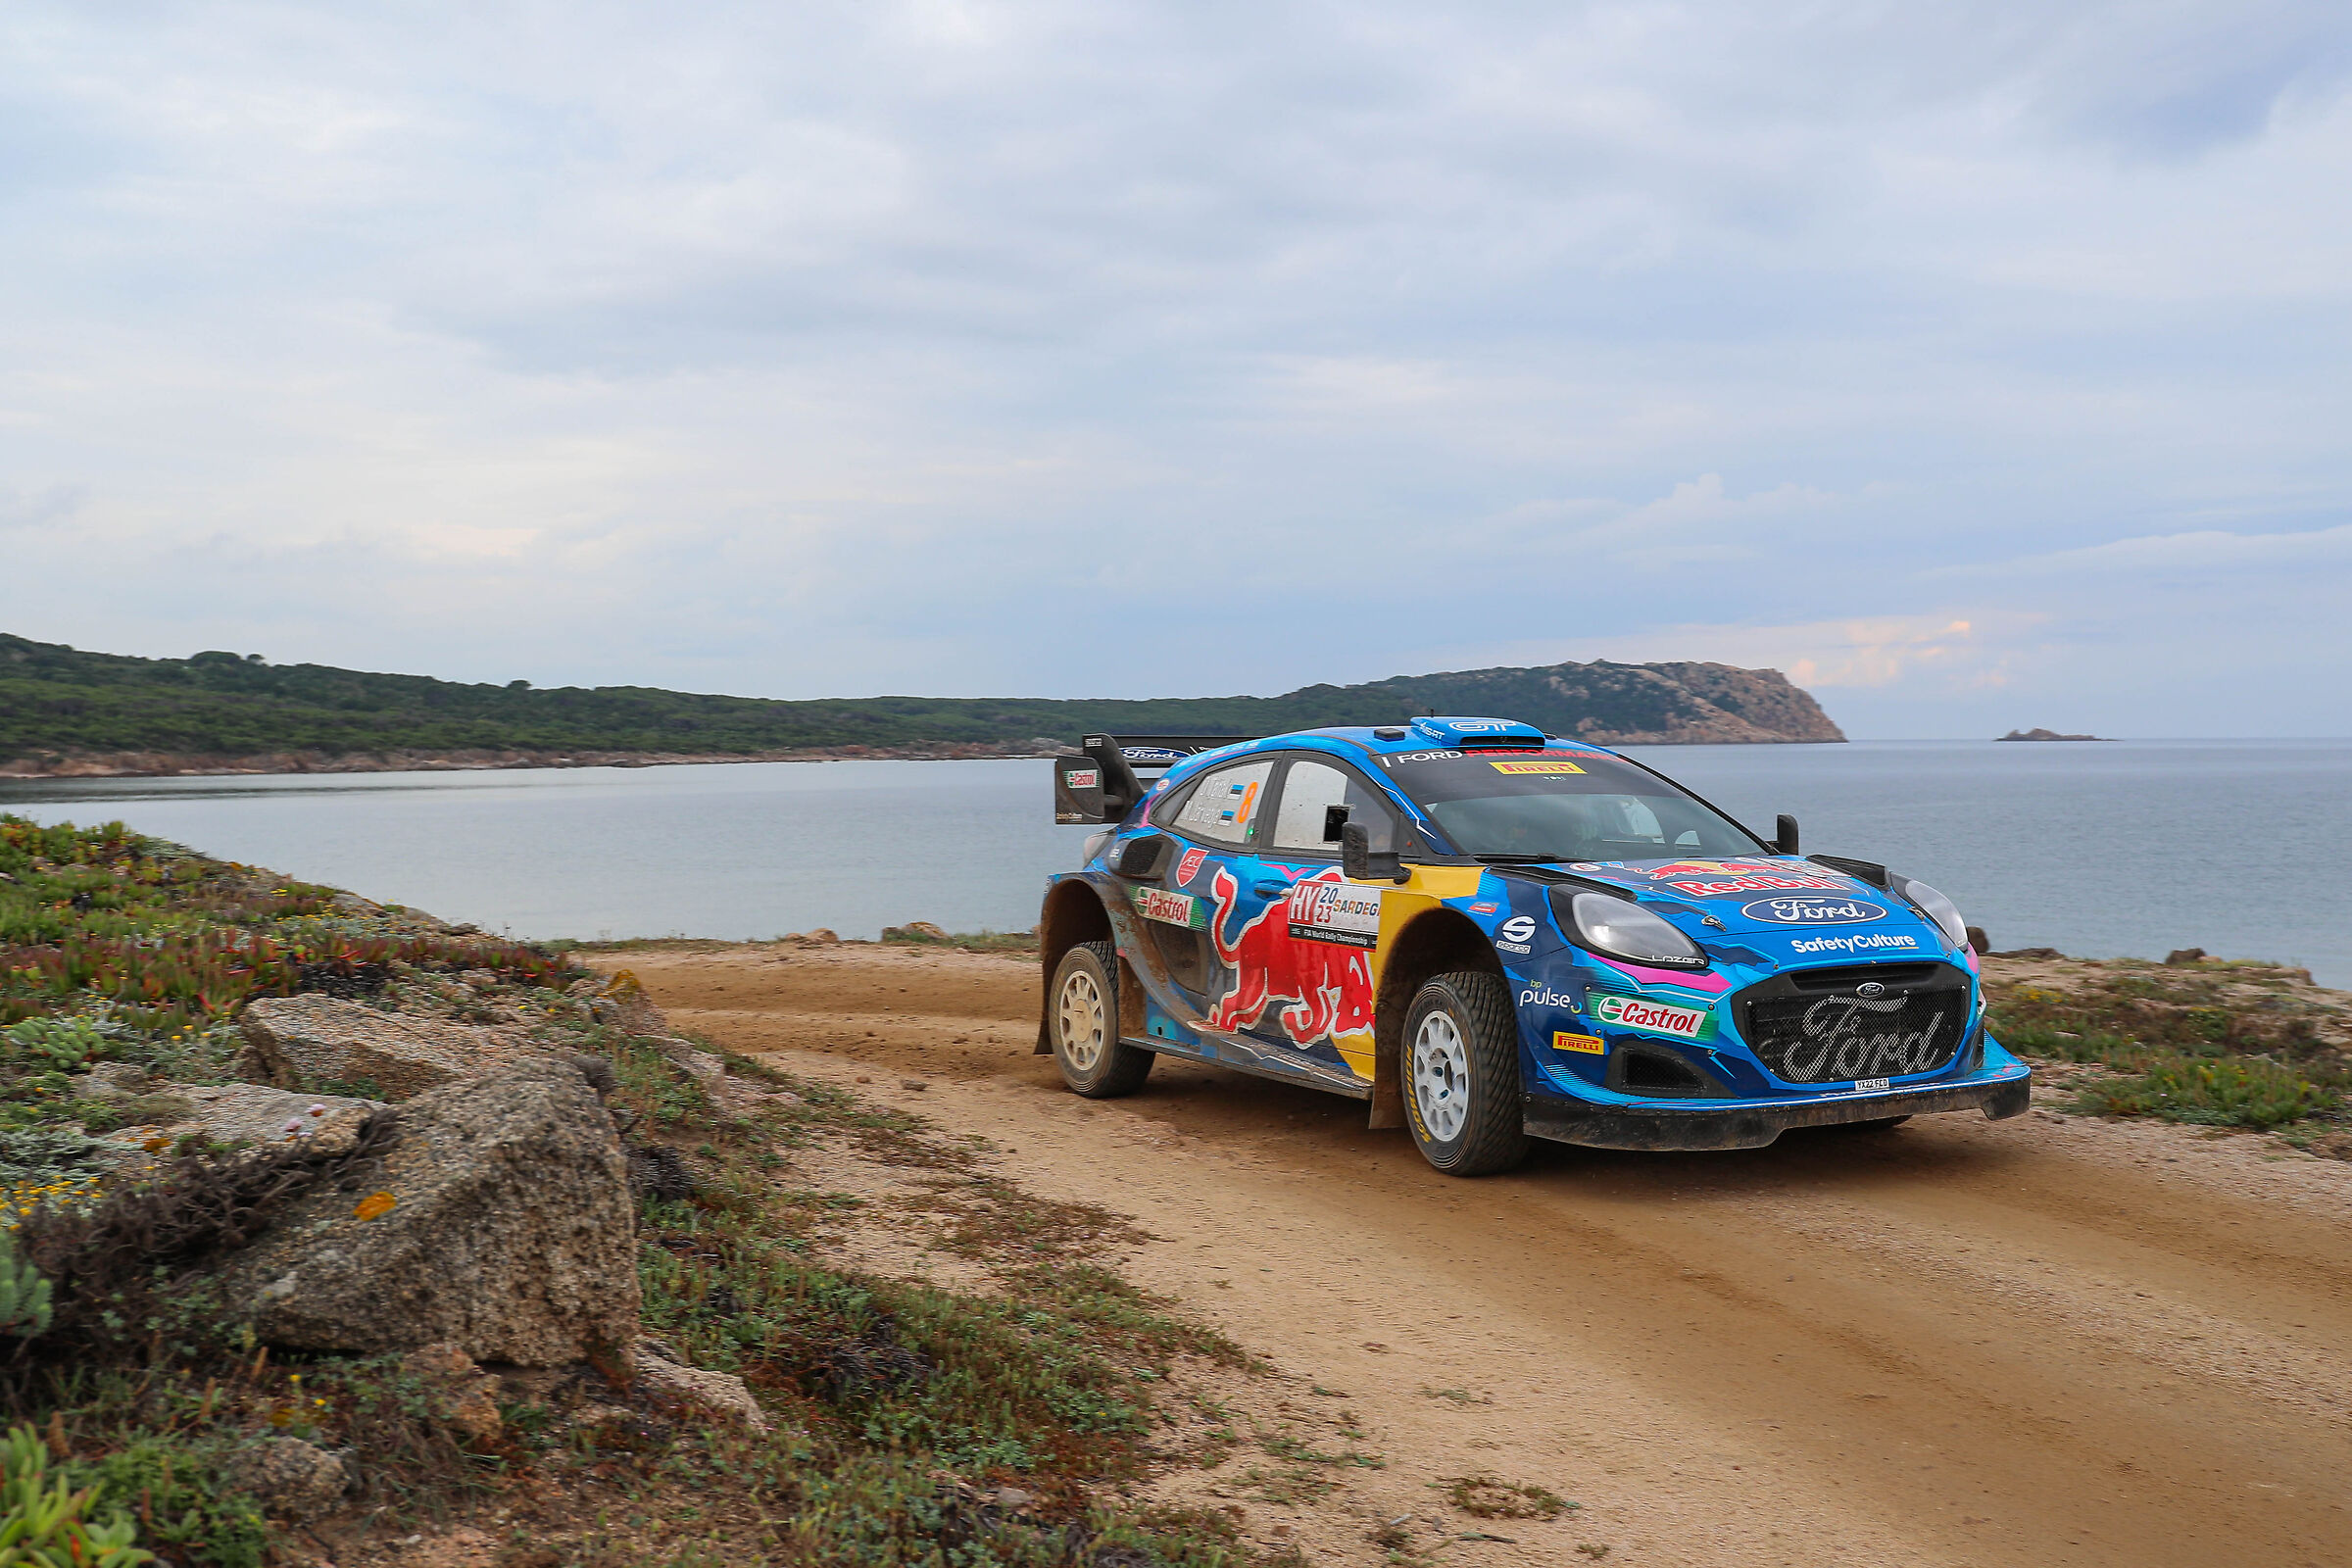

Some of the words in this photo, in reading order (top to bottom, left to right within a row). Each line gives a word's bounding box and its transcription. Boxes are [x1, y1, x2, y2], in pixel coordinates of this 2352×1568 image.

[1396, 751, 1463, 764] FORD
[1502, 763, 1575, 773] PIRELLI
[1237, 781, 1258, 823] 8
[1290, 885, 1320, 921] HY
[1320, 887, 1339, 904] 20
[1148, 893, 1189, 922] Castrol
[1316, 905, 1332, 923] 23
[1333, 900, 1380, 917] SARDEG
[1769, 899, 1866, 920] Ford
[1498, 942, 1530, 953] sparco
[1790, 934, 1917, 954] SafetyCulture
[1652, 956, 1705, 965] LAZER
[1530, 980, 1543, 989] bp
[1519, 988, 1571, 1007] pulse
[1623, 1003, 1697, 1033] Castrol
[1557, 1035, 1599, 1052] PIRELLI
[1783, 996, 1944, 1082] Ford
[1405, 1043, 1432, 1144] SCORPION
